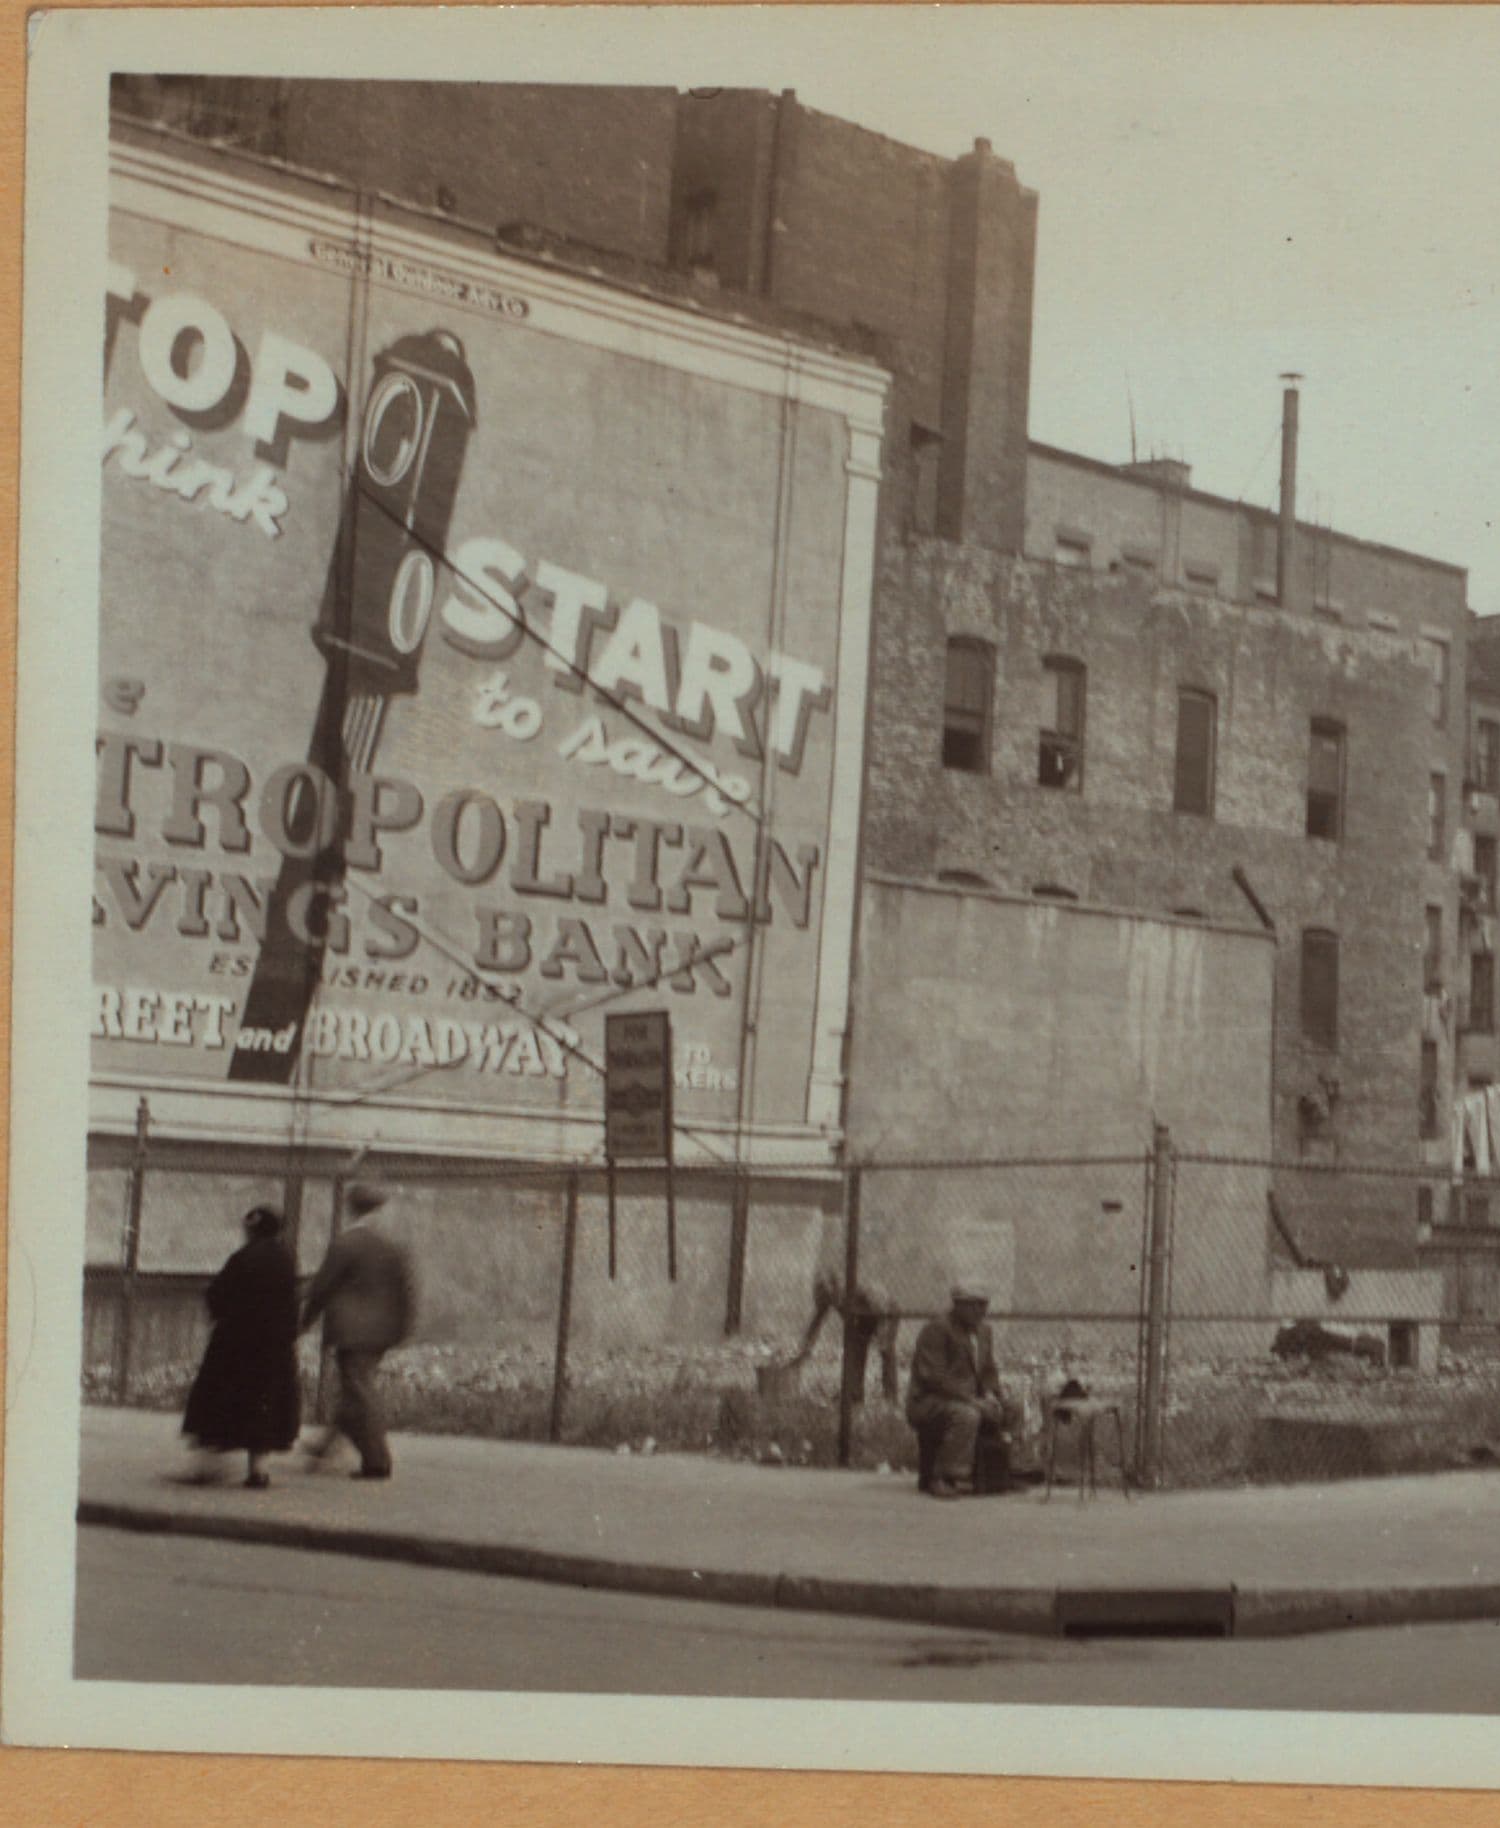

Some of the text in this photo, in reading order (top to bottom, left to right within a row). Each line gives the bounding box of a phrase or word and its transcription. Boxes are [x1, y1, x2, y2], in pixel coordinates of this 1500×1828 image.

[441, 537, 830, 770] START
[473, 672, 543, 740] to
[558, 717, 752, 816] save
[94, 732, 819, 929] TROPOLITAN
[93, 857, 732, 998] VINGS BANK
[237, 1021, 296, 1052] and
[309, 1008, 581, 1079] BROADWAY
